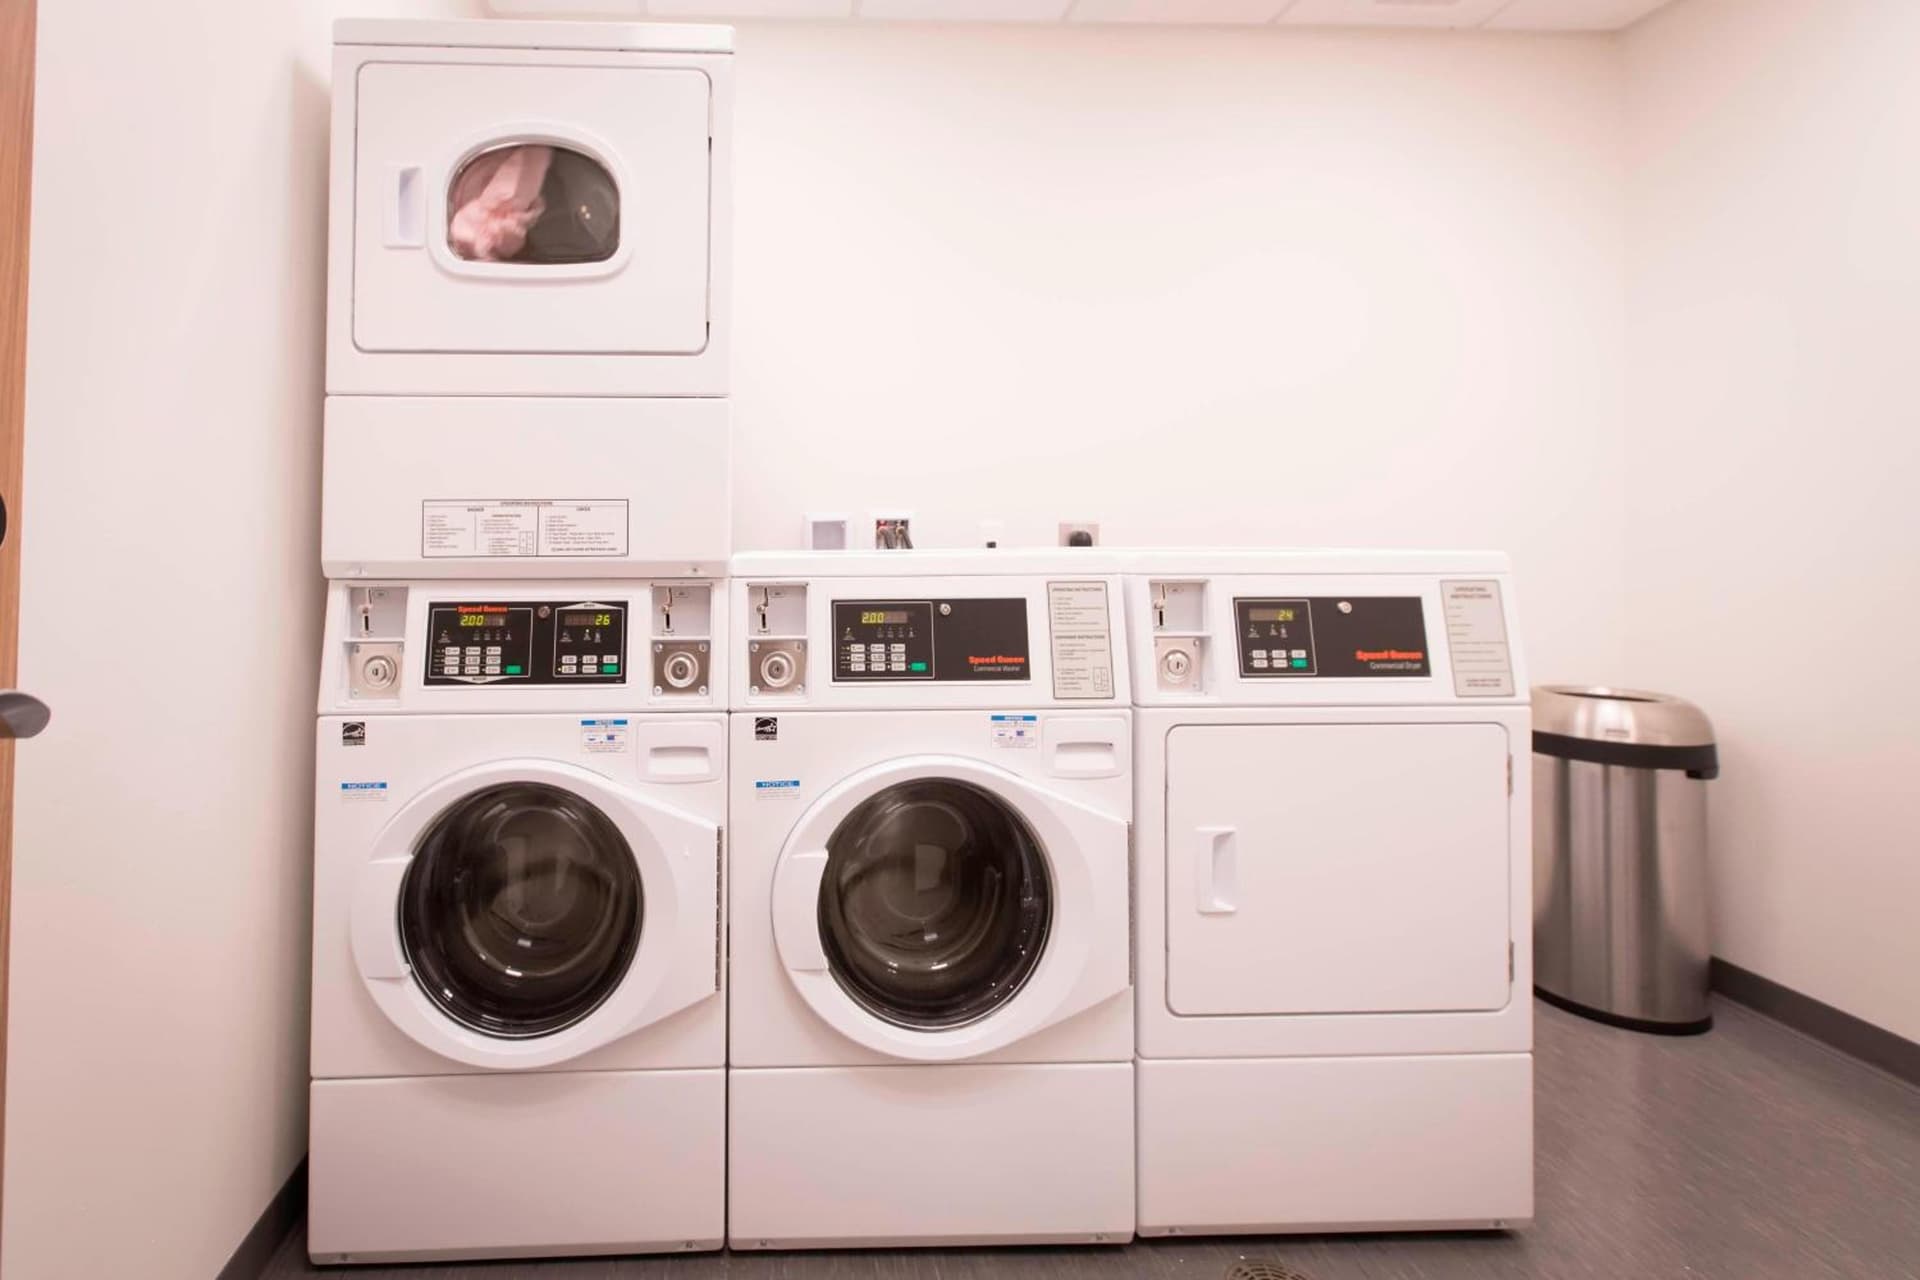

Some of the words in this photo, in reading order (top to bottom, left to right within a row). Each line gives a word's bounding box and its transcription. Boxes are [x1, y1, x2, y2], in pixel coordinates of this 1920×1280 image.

[458, 605, 482, 614] Speed
[483, 605, 508, 613] Queen
[594, 614, 610, 626] 26
[1356, 649, 1388, 661] Speed
[1389, 649, 1423, 660] Queen
[968, 656, 996, 664] Speed
[997, 656, 1025, 664] Queen
[1369, 662, 1404, 670] Commercial
